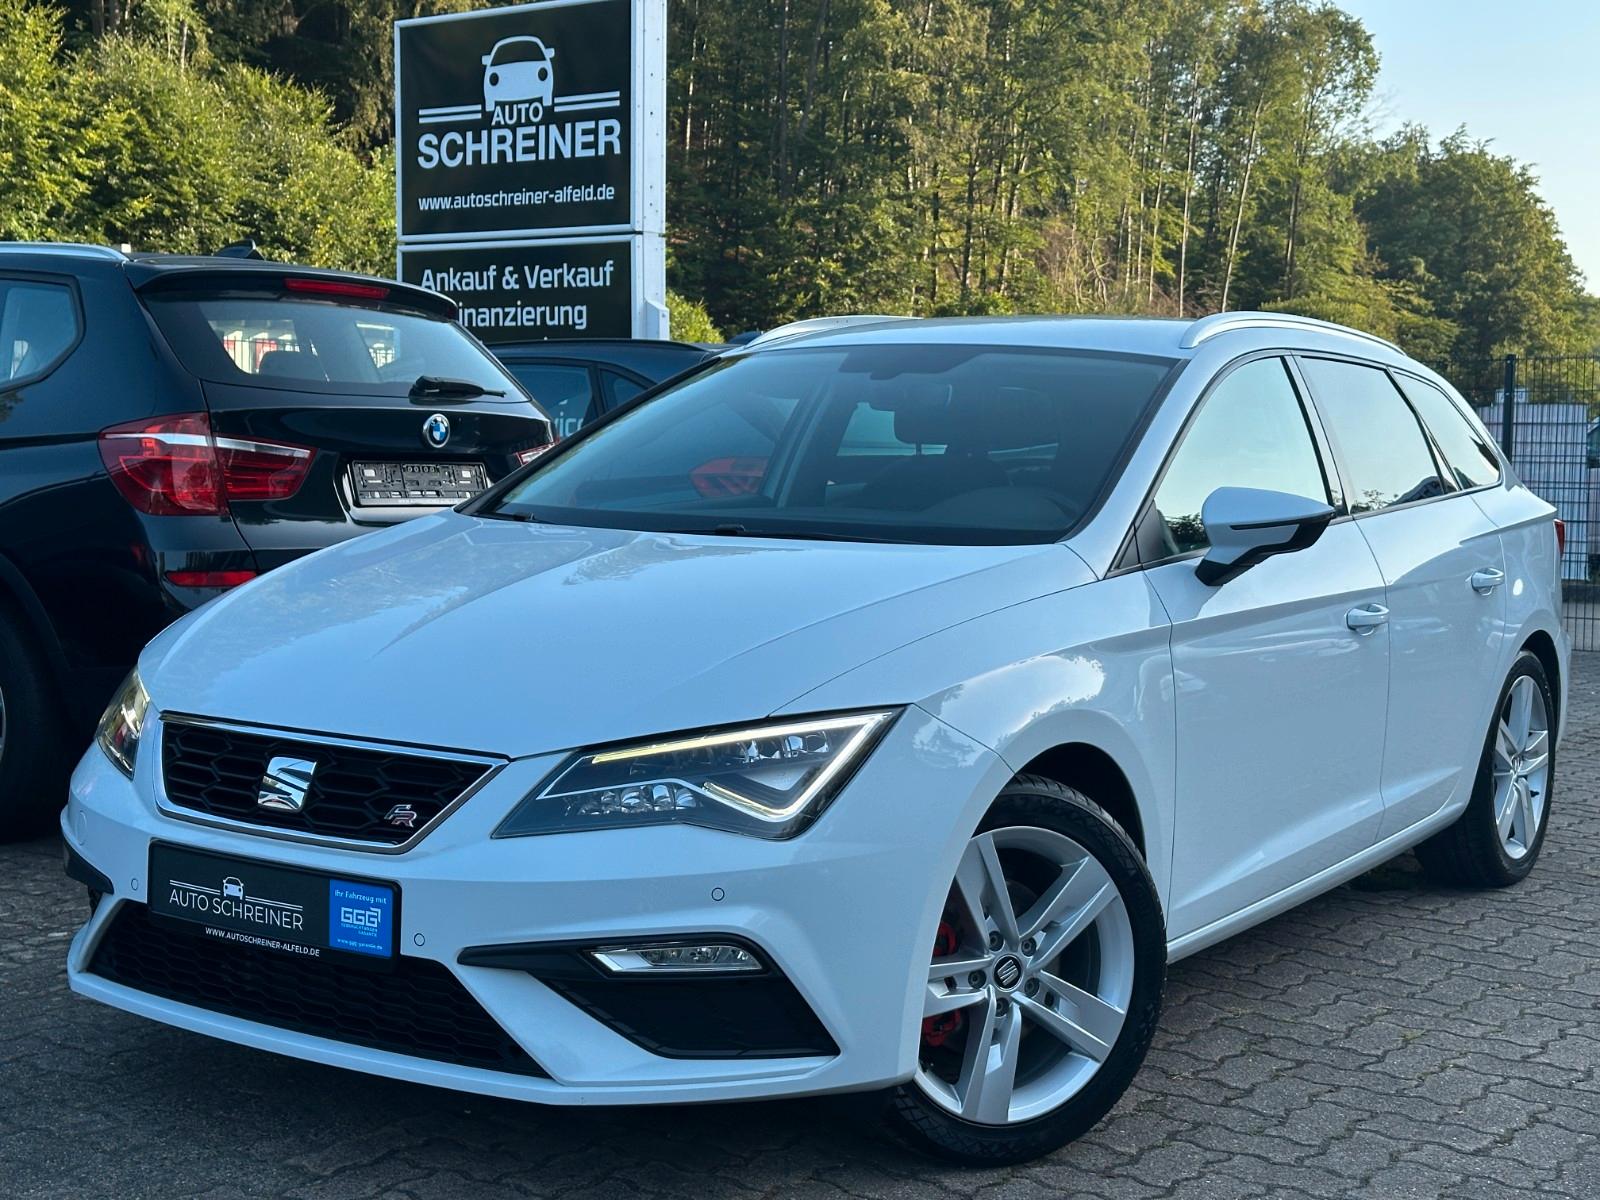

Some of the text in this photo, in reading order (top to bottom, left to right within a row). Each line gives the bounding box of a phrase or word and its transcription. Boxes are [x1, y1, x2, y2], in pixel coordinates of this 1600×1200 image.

[491, 101, 544, 126] AUTO
[417, 118, 622, 170] SCHREINER
[418, 183, 616, 211] www.autoschreiner-alfeld.de
[420, 260, 615, 292] Ankauf & Verkauf
[458, 300, 588, 330] inanzierung
[169, 888, 304, 932] AUTO SCHREINER
[205, 926, 320, 957] WWW.AUTOSCHREINER-ALFELD.DE
